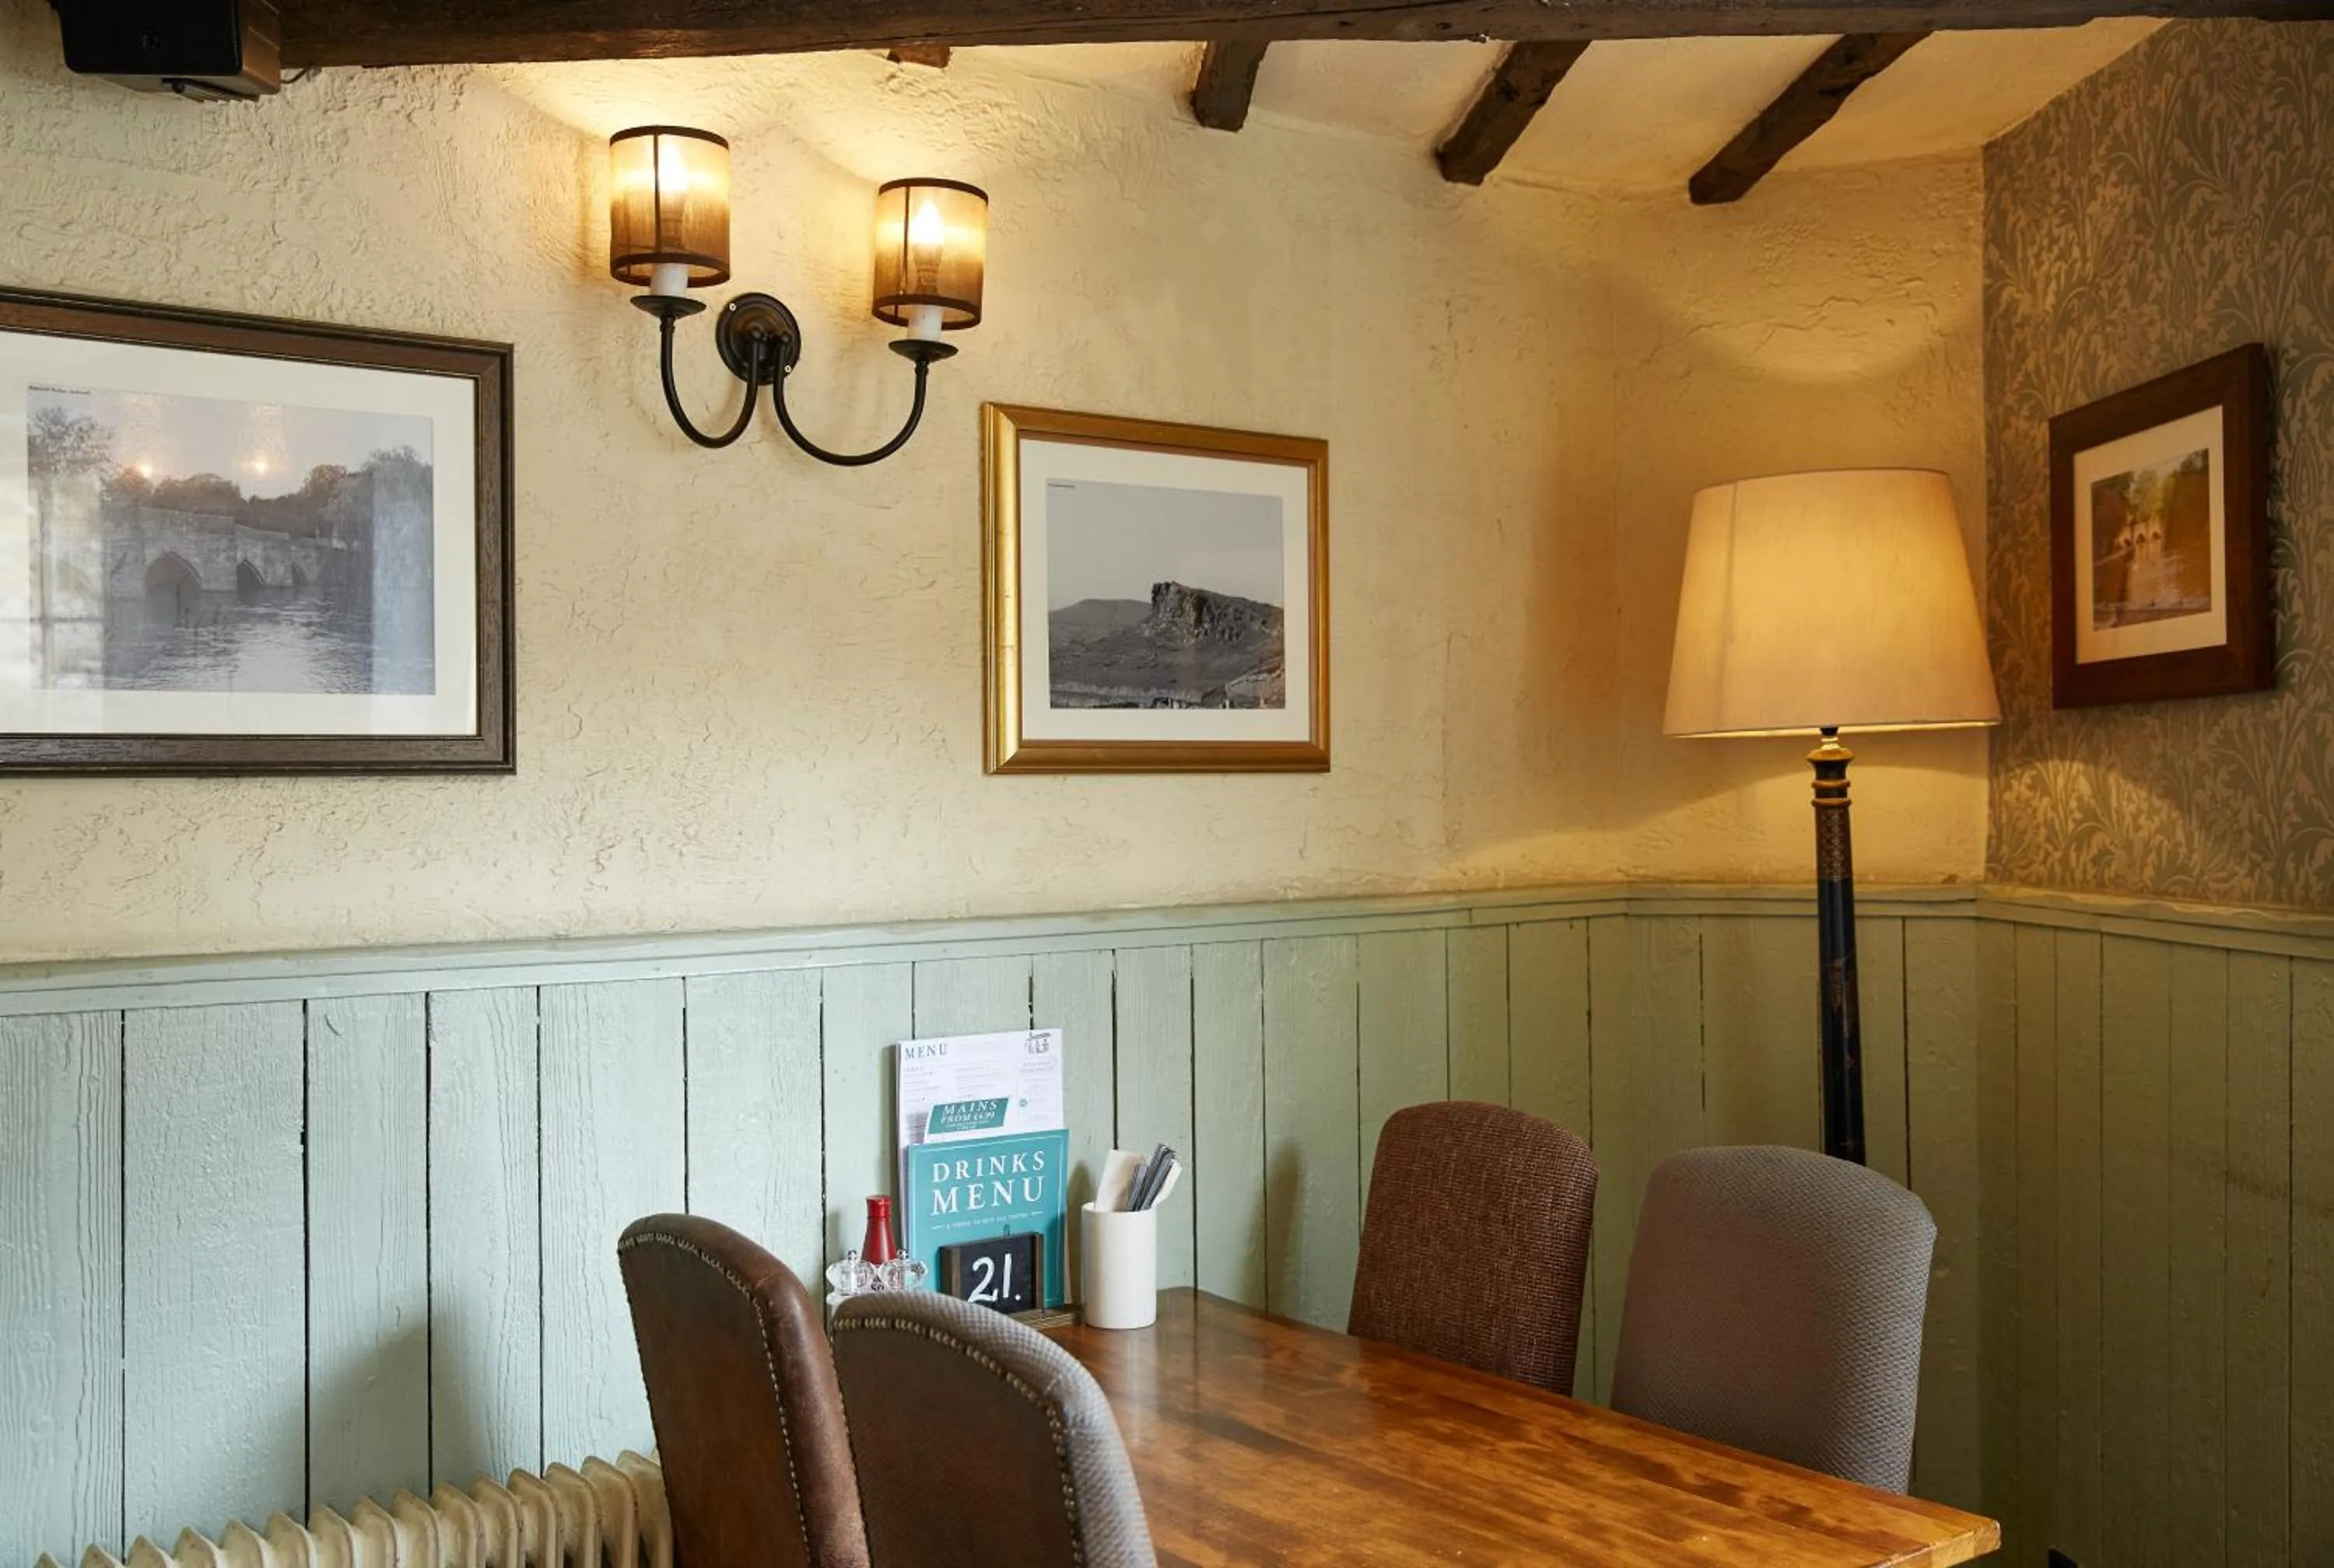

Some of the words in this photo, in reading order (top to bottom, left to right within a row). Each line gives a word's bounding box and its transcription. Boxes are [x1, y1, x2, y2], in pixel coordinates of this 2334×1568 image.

[904, 1044, 948, 1059] MENU
[944, 1101, 997, 1115] MAINS
[933, 1150, 1046, 1183] DRINKS
[930, 1175, 1045, 1216] MENU
